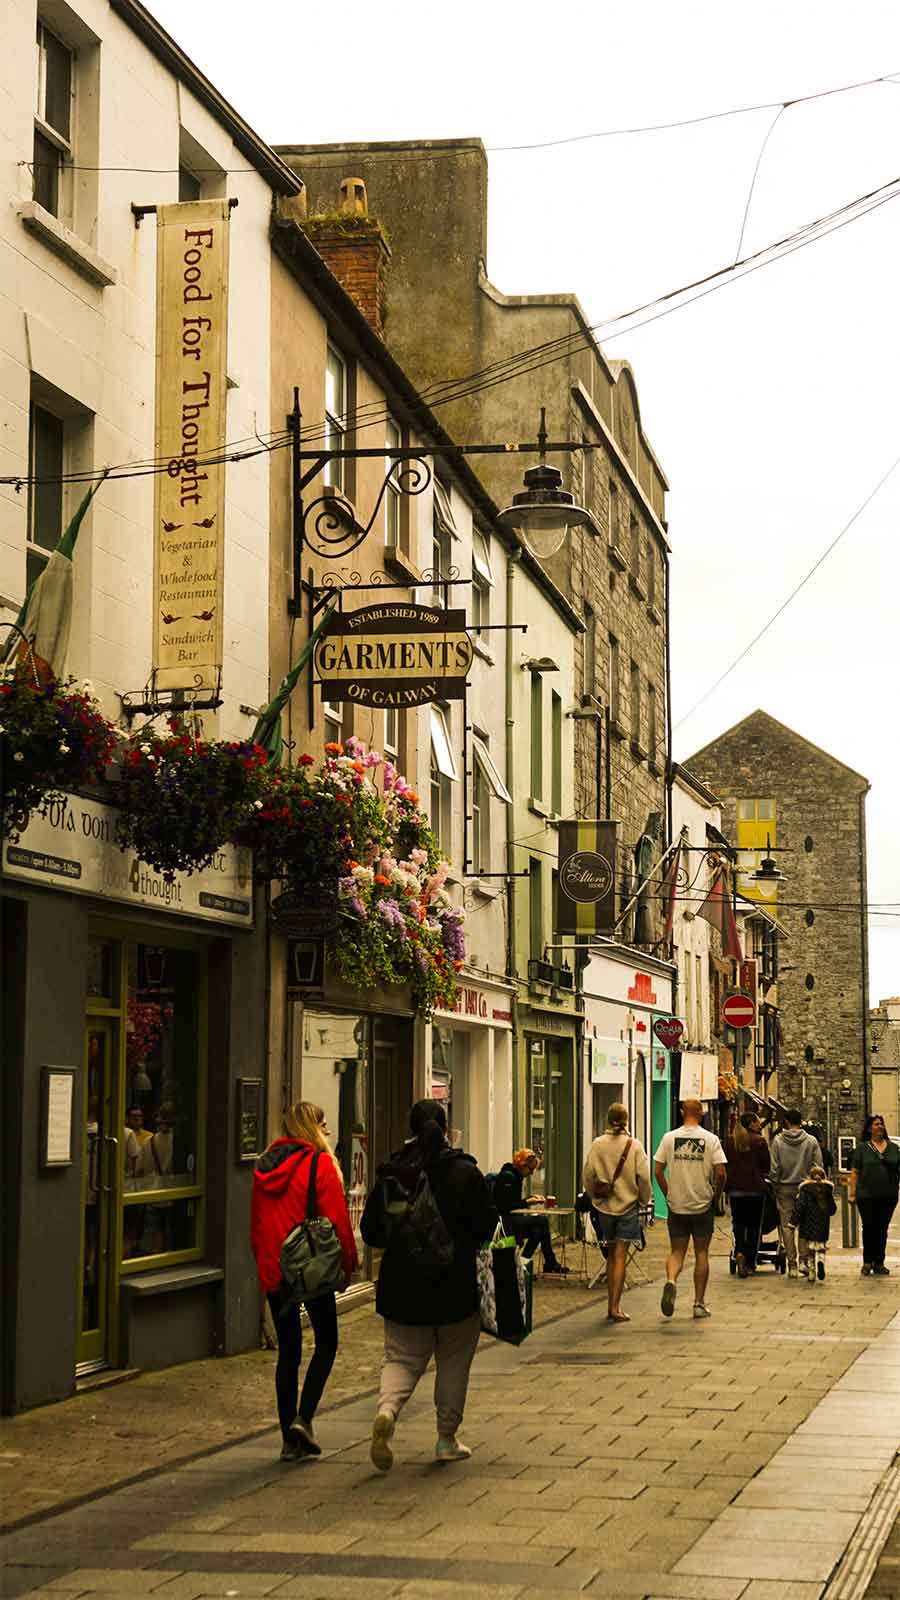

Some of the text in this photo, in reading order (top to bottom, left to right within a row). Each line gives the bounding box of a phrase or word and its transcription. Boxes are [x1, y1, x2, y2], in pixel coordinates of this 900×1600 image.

[167, 228, 214, 507] Food for Thought
[160, 538, 217, 554] Vegetarian
[182, 554, 193, 567] &
[160, 569, 217, 585] Wholefood
[160, 589, 217, 602] Restaurant
[348, 608, 440, 628] ESTABLISHED 1989
[161, 629, 214, 646] Sandwich
[177, 649, 199, 661] Bar
[319, 641, 469, 671] GARMENTS
[347, 683, 437, 704] OF GALWAY
